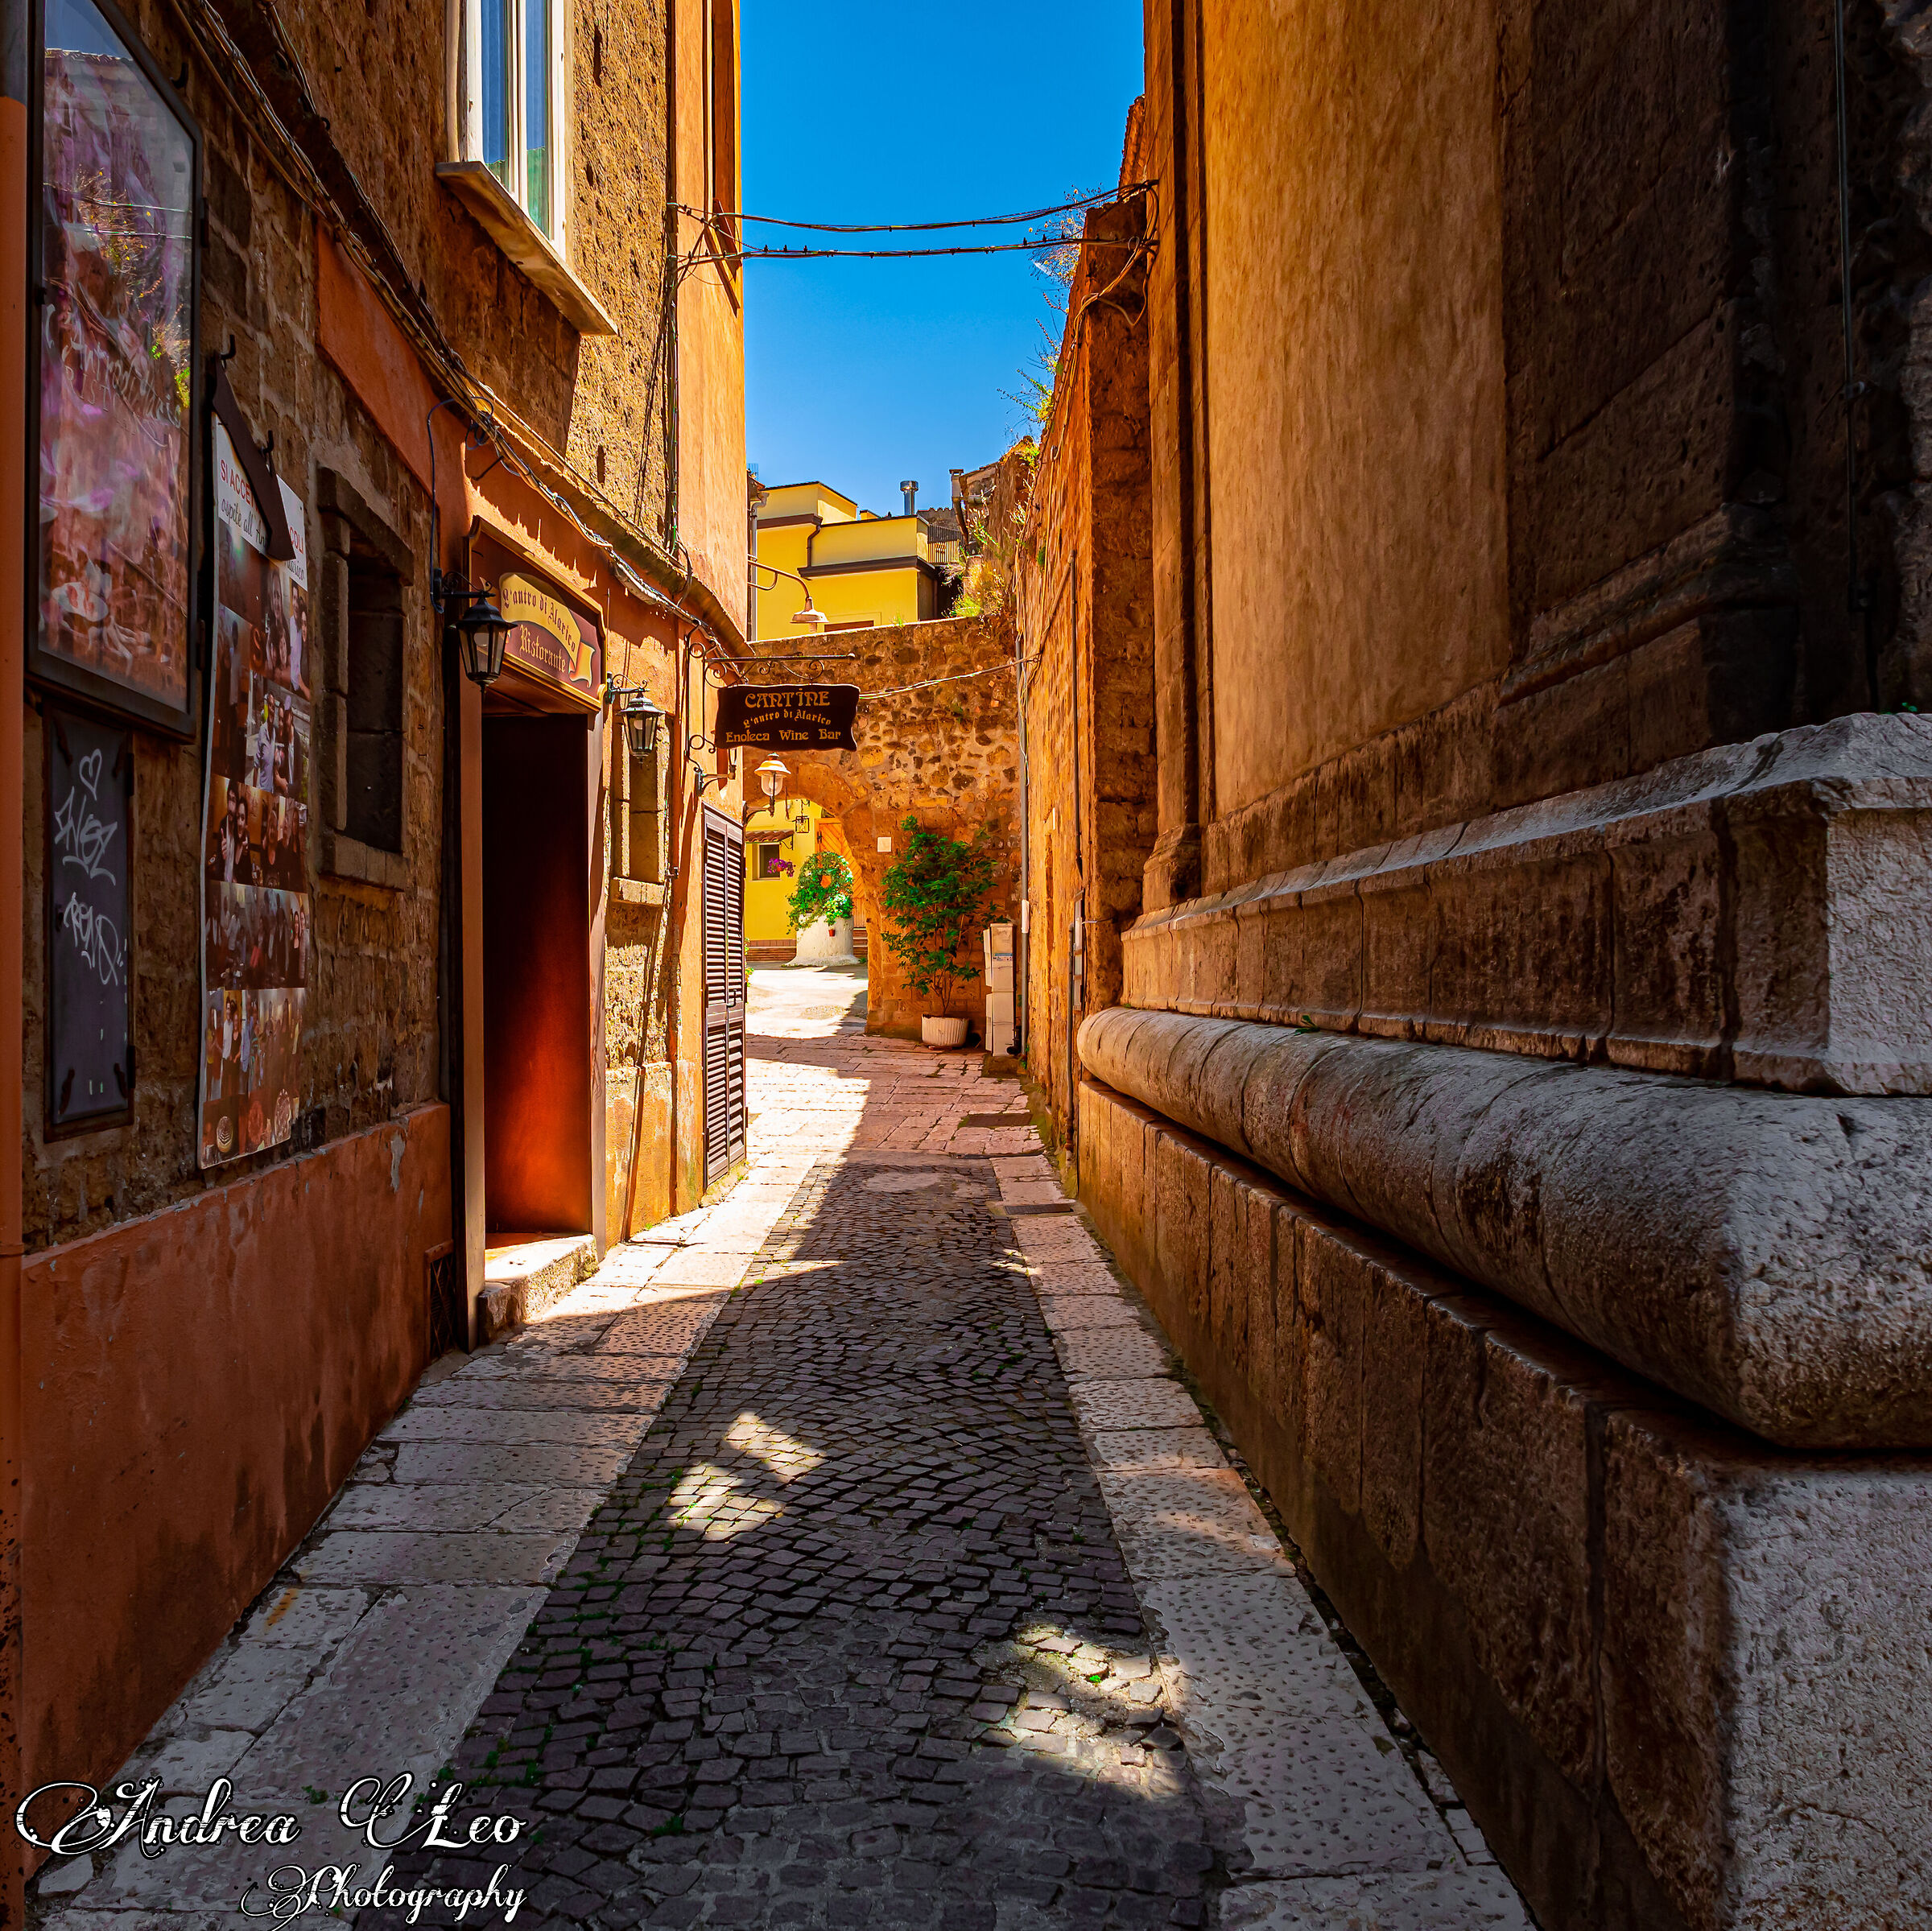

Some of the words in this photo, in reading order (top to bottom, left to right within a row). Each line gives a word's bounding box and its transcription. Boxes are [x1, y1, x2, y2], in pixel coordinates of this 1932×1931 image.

[539, 592, 547, 614] di
[547, 602, 576, 653] Alarico
[519, 624, 566, 674] Ristorante
[725, 728, 770, 743] Enoteca
[778, 729, 809, 741] Wine
[818, 728, 841, 740] Bar
[743, 712, 780, 728] L'antro
[783, 708, 793, 719] di
[795, 709, 832, 726] Alarico
